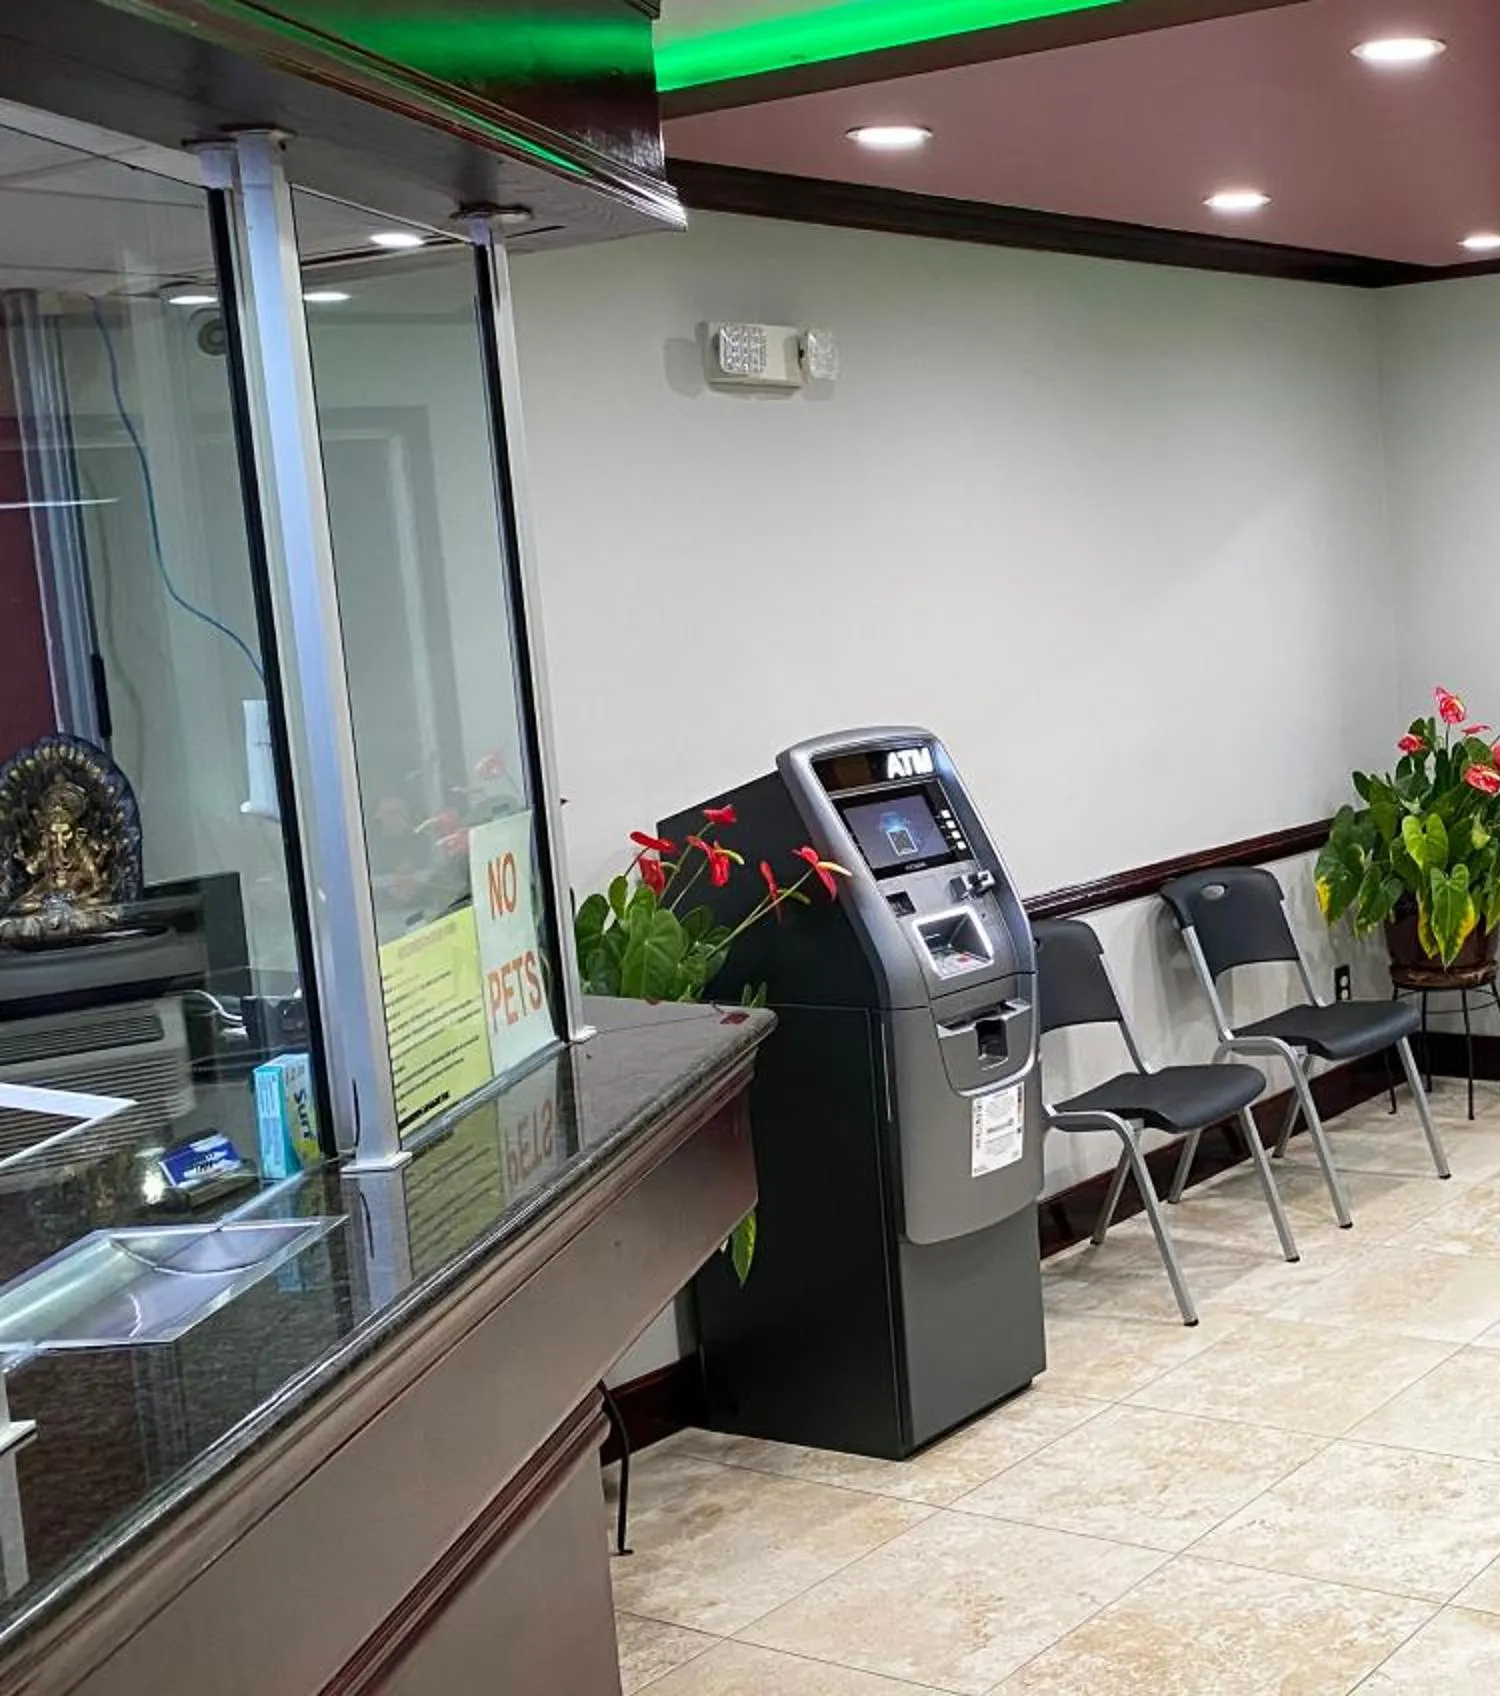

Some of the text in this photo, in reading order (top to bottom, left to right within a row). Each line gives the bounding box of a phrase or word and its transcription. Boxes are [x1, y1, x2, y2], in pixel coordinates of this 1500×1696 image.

[888, 747, 933, 778] ATM
[488, 853, 517, 920] NO
[487, 951, 542, 1033] PETS
